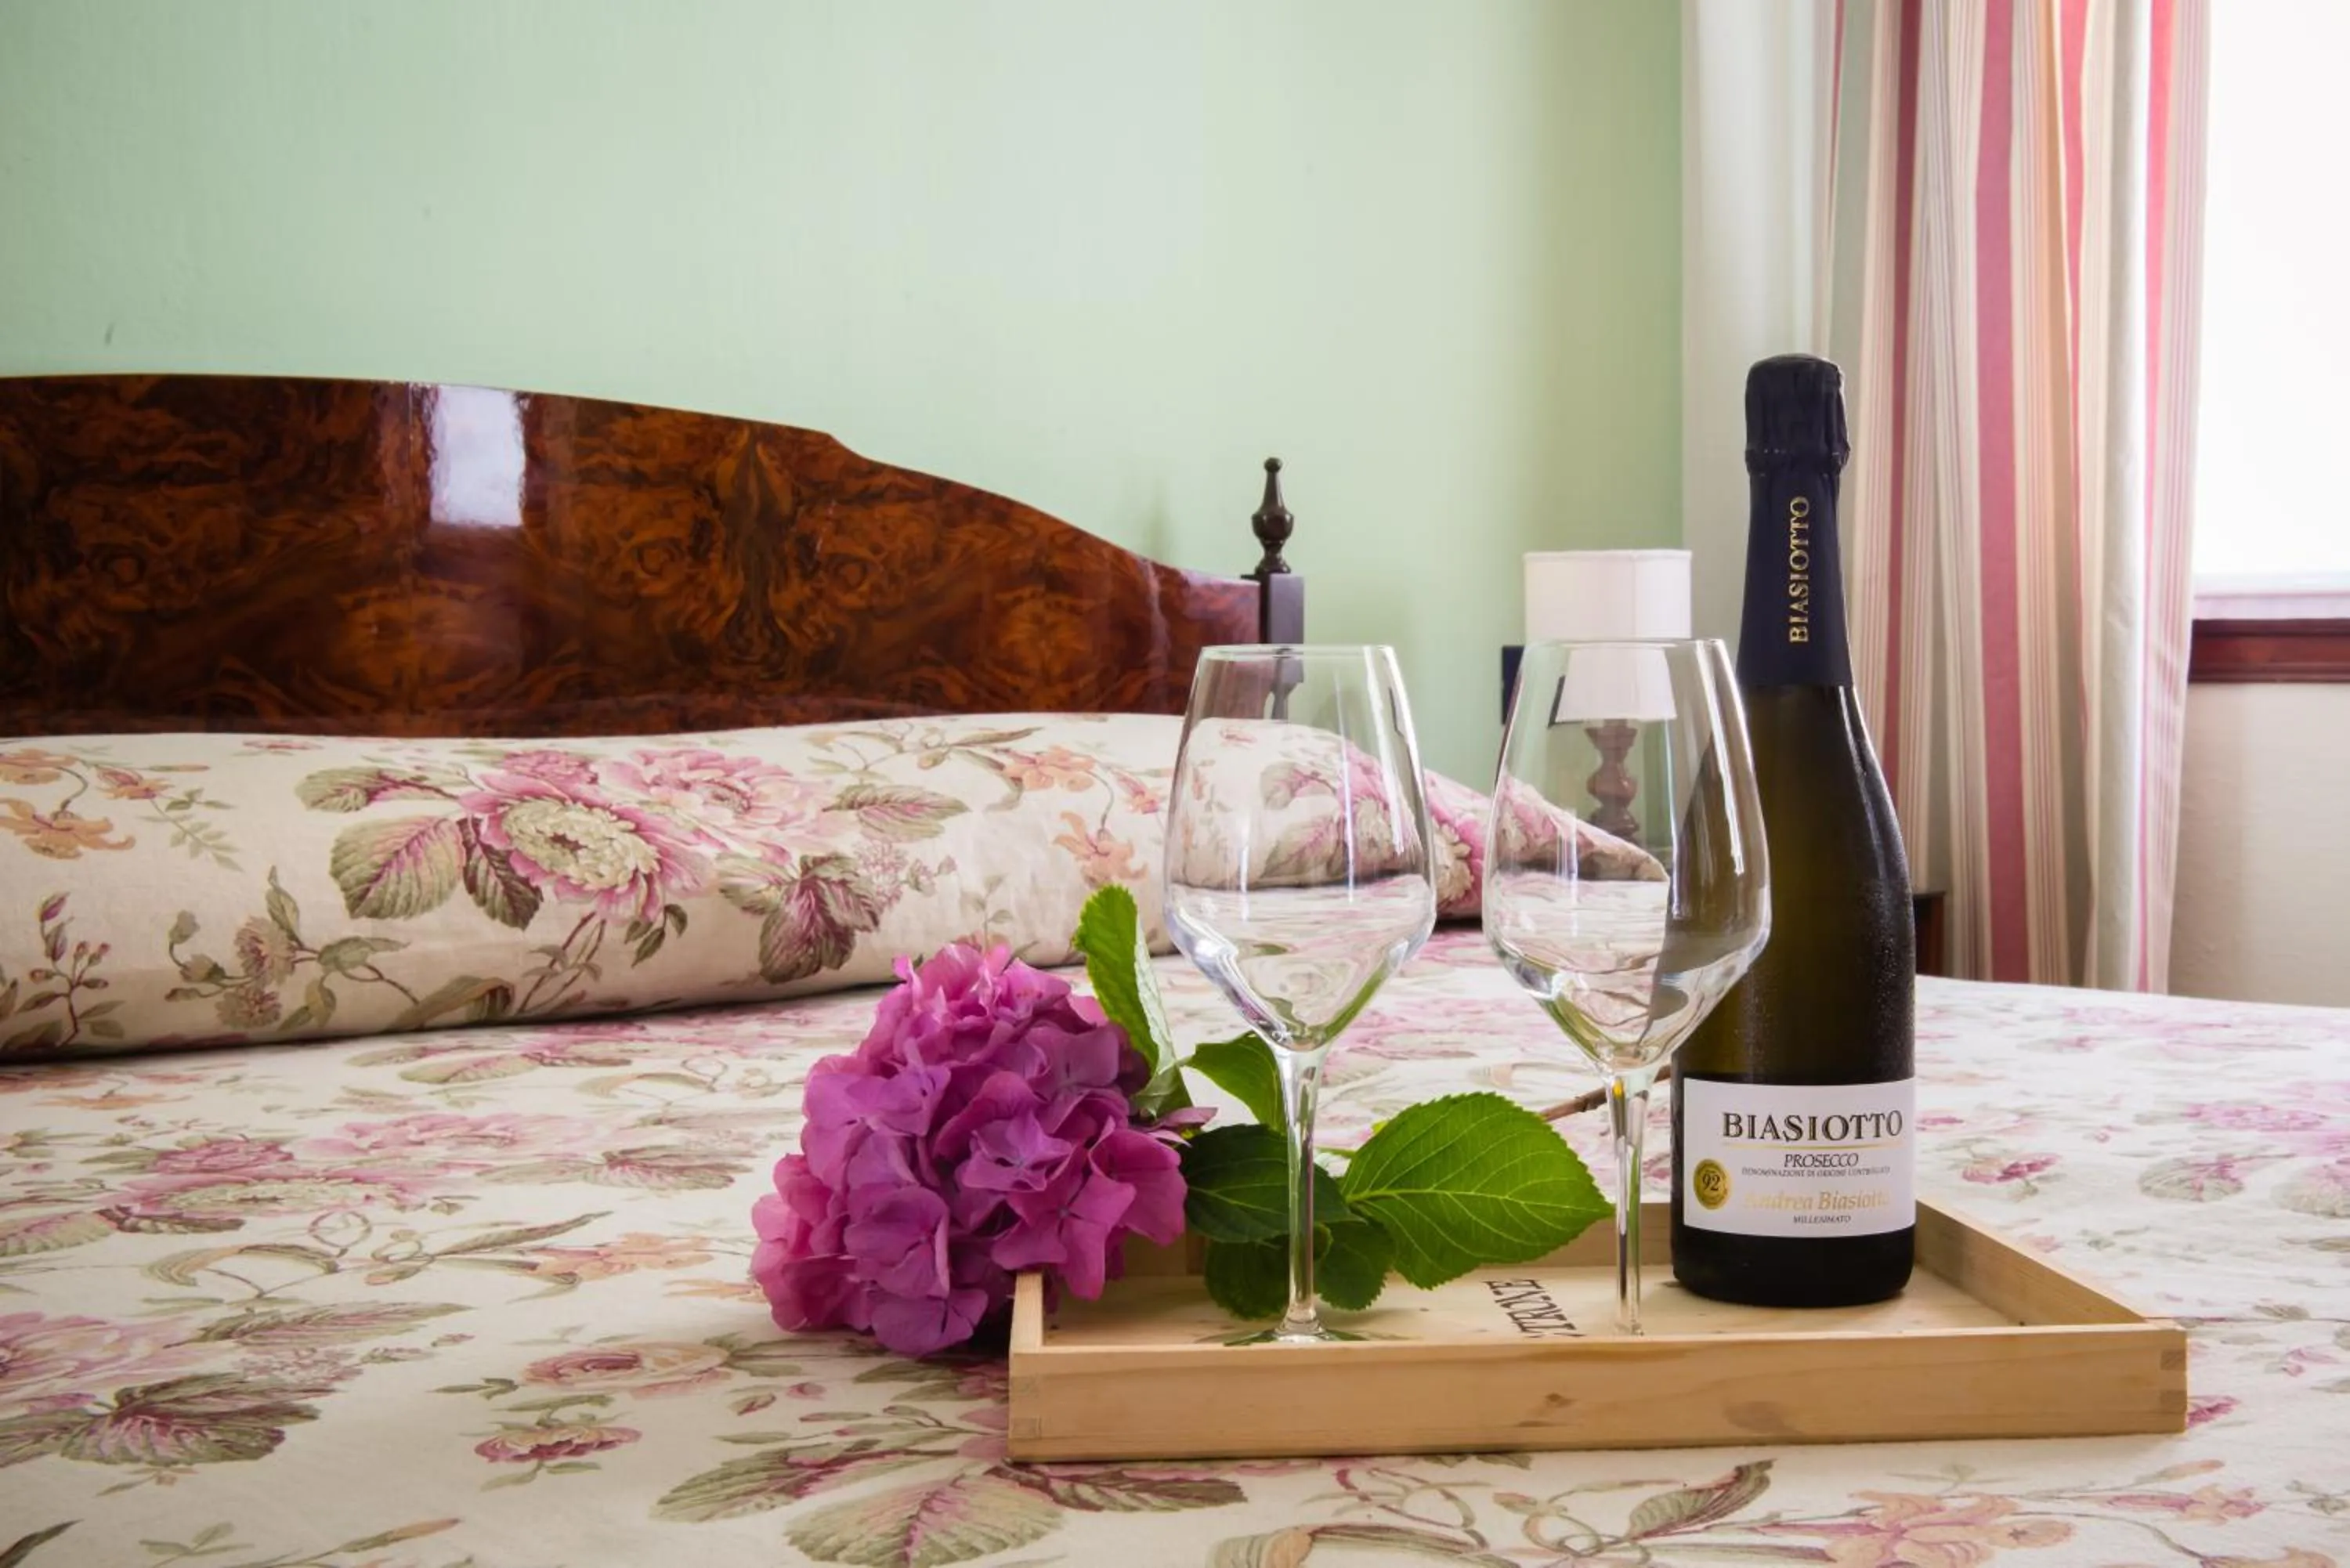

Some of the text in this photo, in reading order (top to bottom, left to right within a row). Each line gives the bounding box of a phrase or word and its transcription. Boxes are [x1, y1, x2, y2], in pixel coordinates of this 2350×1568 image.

[1788, 495, 1810, 644] BIASIOTTO
[1723, 1110, 1904, 1142] BIASIOTTO
[1783, 1152, 1860, 1169] PROSECCO
[1702, 1173, 1721, 1191] 92
[1744, 1190, 1813, 1211] Andrea
